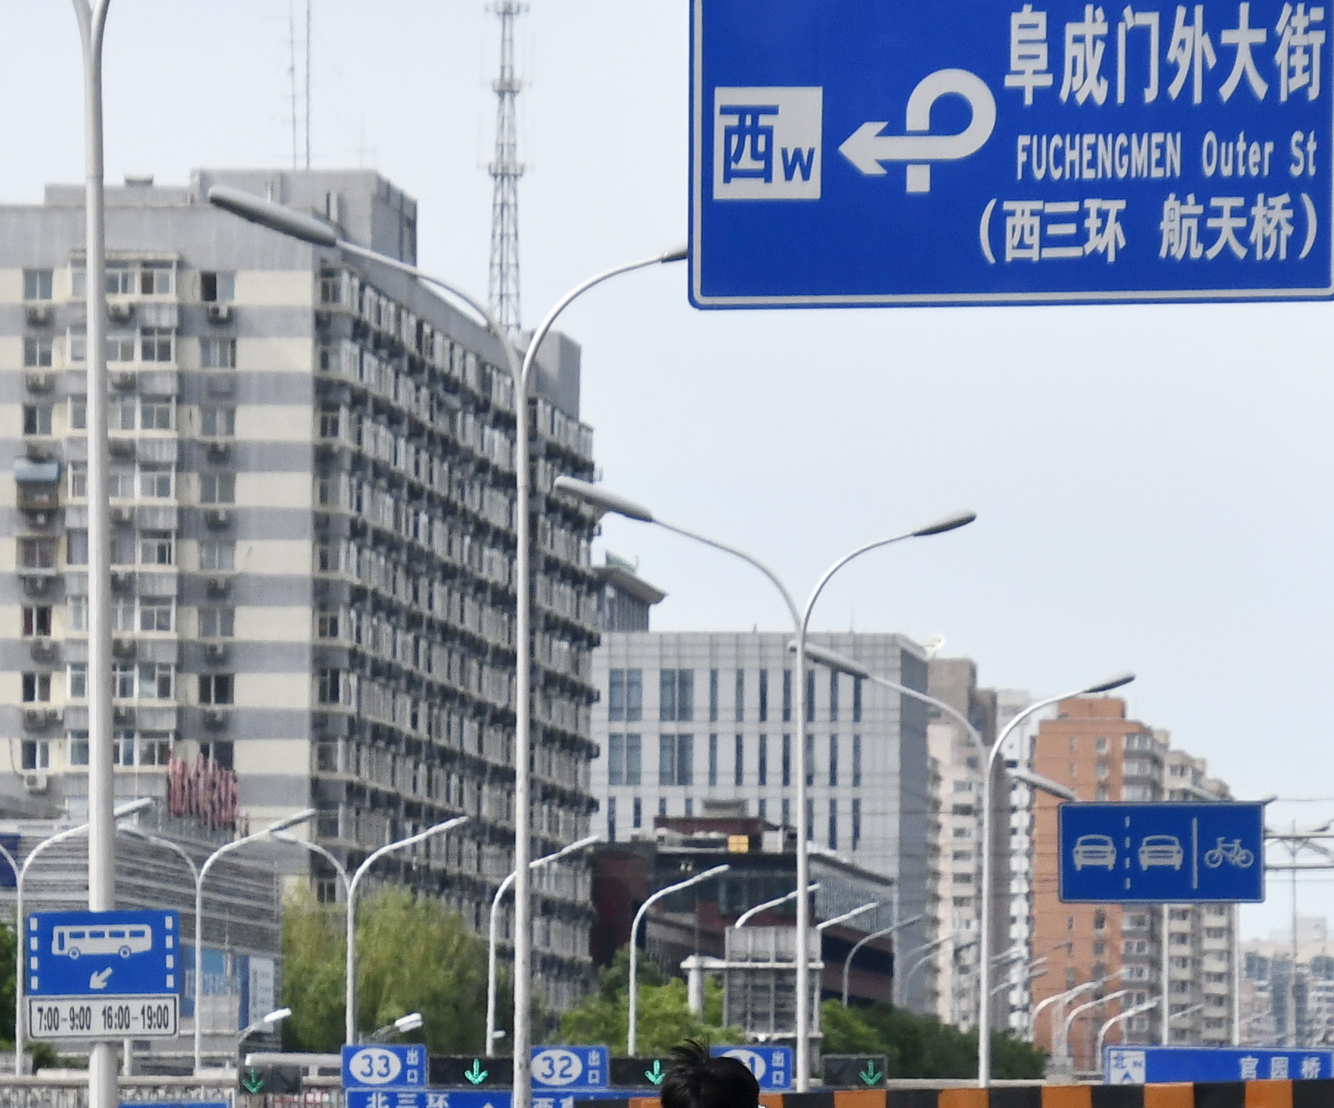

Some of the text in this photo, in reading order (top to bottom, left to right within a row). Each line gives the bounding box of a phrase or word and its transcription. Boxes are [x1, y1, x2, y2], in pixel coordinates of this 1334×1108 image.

[1004, 3, 1326, 106] 阜成门外大街
[719, 104, 779, 186] 西
[1017, 130, 1317, 181] FUCHENGMEN Outer St
[360, 1054, 391, 1078] 33
[406, 1048, 419, 1083] 出口
[541, 1056, 573, 1079] 32
[587, 1049, 601, 1085] 出口
[772, 1051, 785, 1085] 出口
